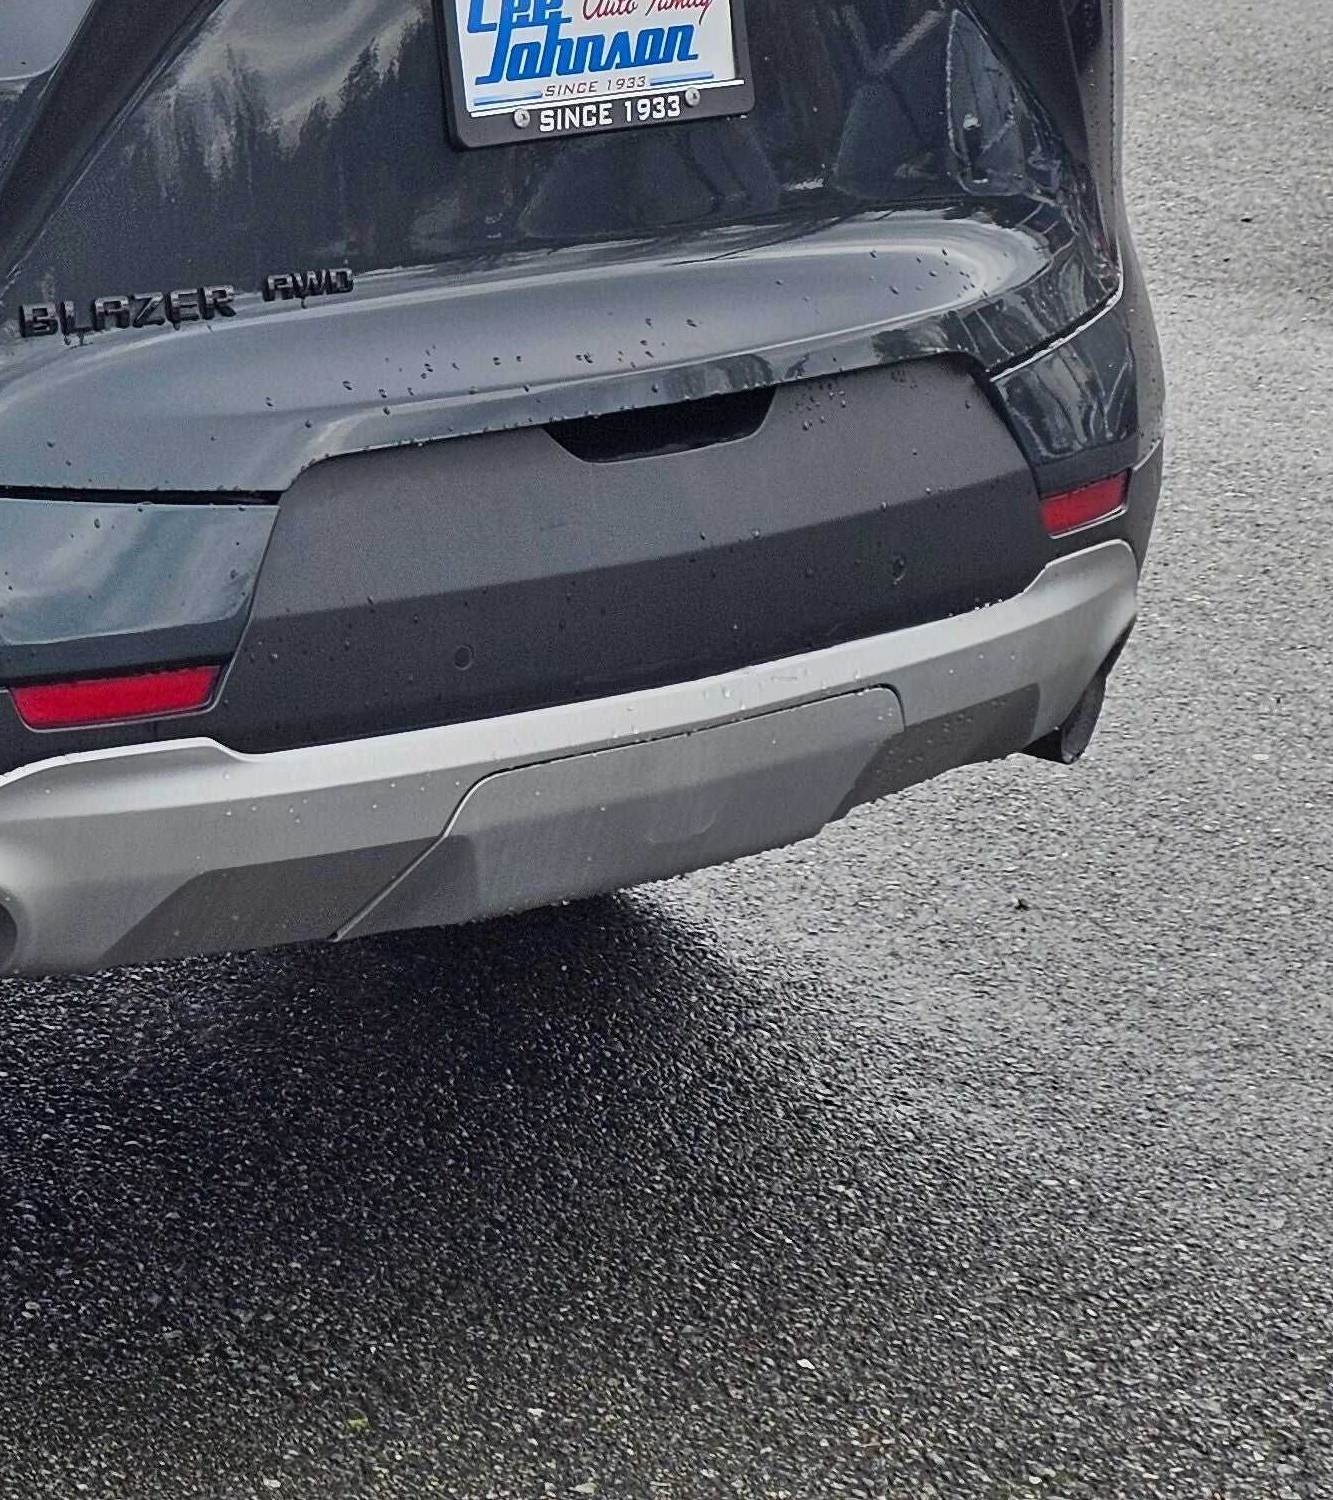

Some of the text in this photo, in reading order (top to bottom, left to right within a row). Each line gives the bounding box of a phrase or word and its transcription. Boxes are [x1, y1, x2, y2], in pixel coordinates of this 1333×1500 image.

[475, 11, 699, 86] Johnson
[540, 95, 681, 132] SINCE 1933
[545, 76, 647, 97] SINCE 1933
[19, 267, 354, 338] BLAZER AWD
